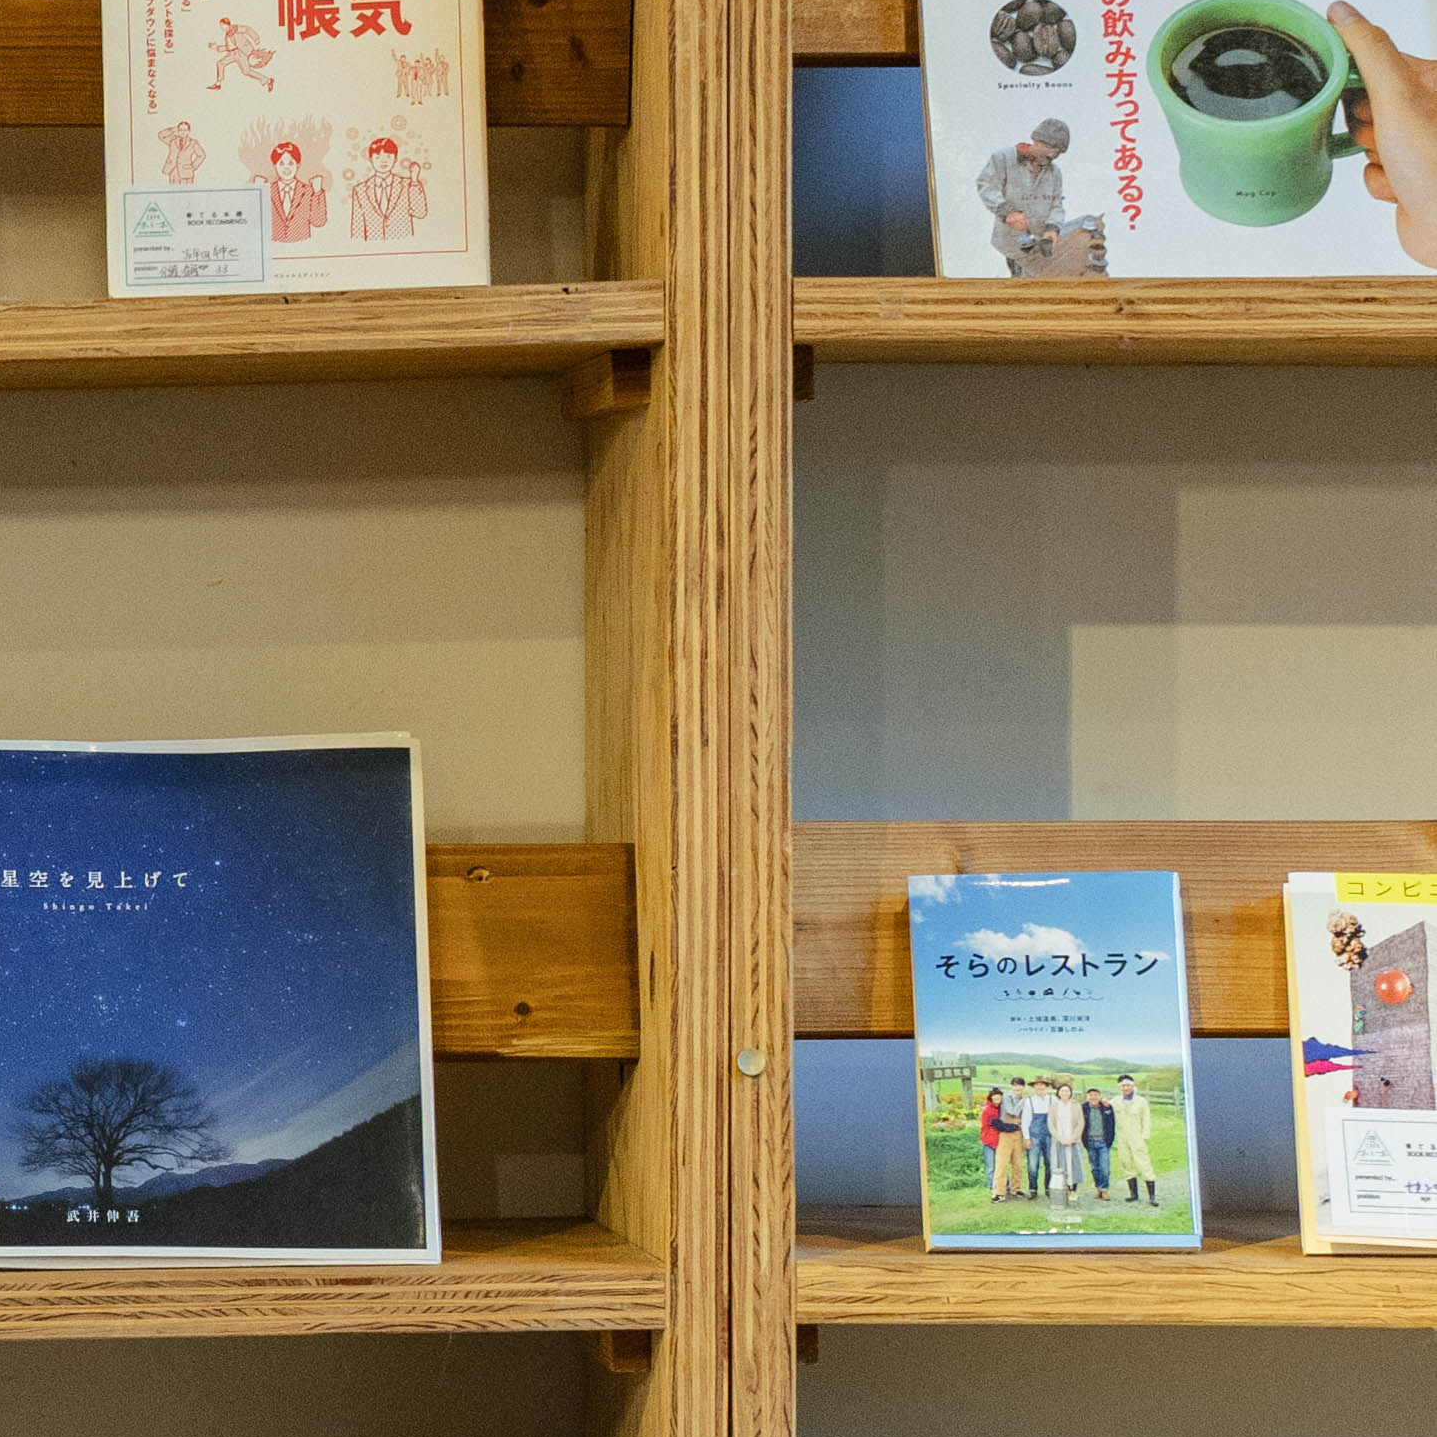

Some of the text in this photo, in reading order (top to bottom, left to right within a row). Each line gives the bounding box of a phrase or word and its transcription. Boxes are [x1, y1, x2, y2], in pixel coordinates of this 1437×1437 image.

[0, 869, 190, 891] 星空を見上げて
[42, 901, 150, 912] Shingo Takei
[934, 952, 1160, 980] そらのレストラン
